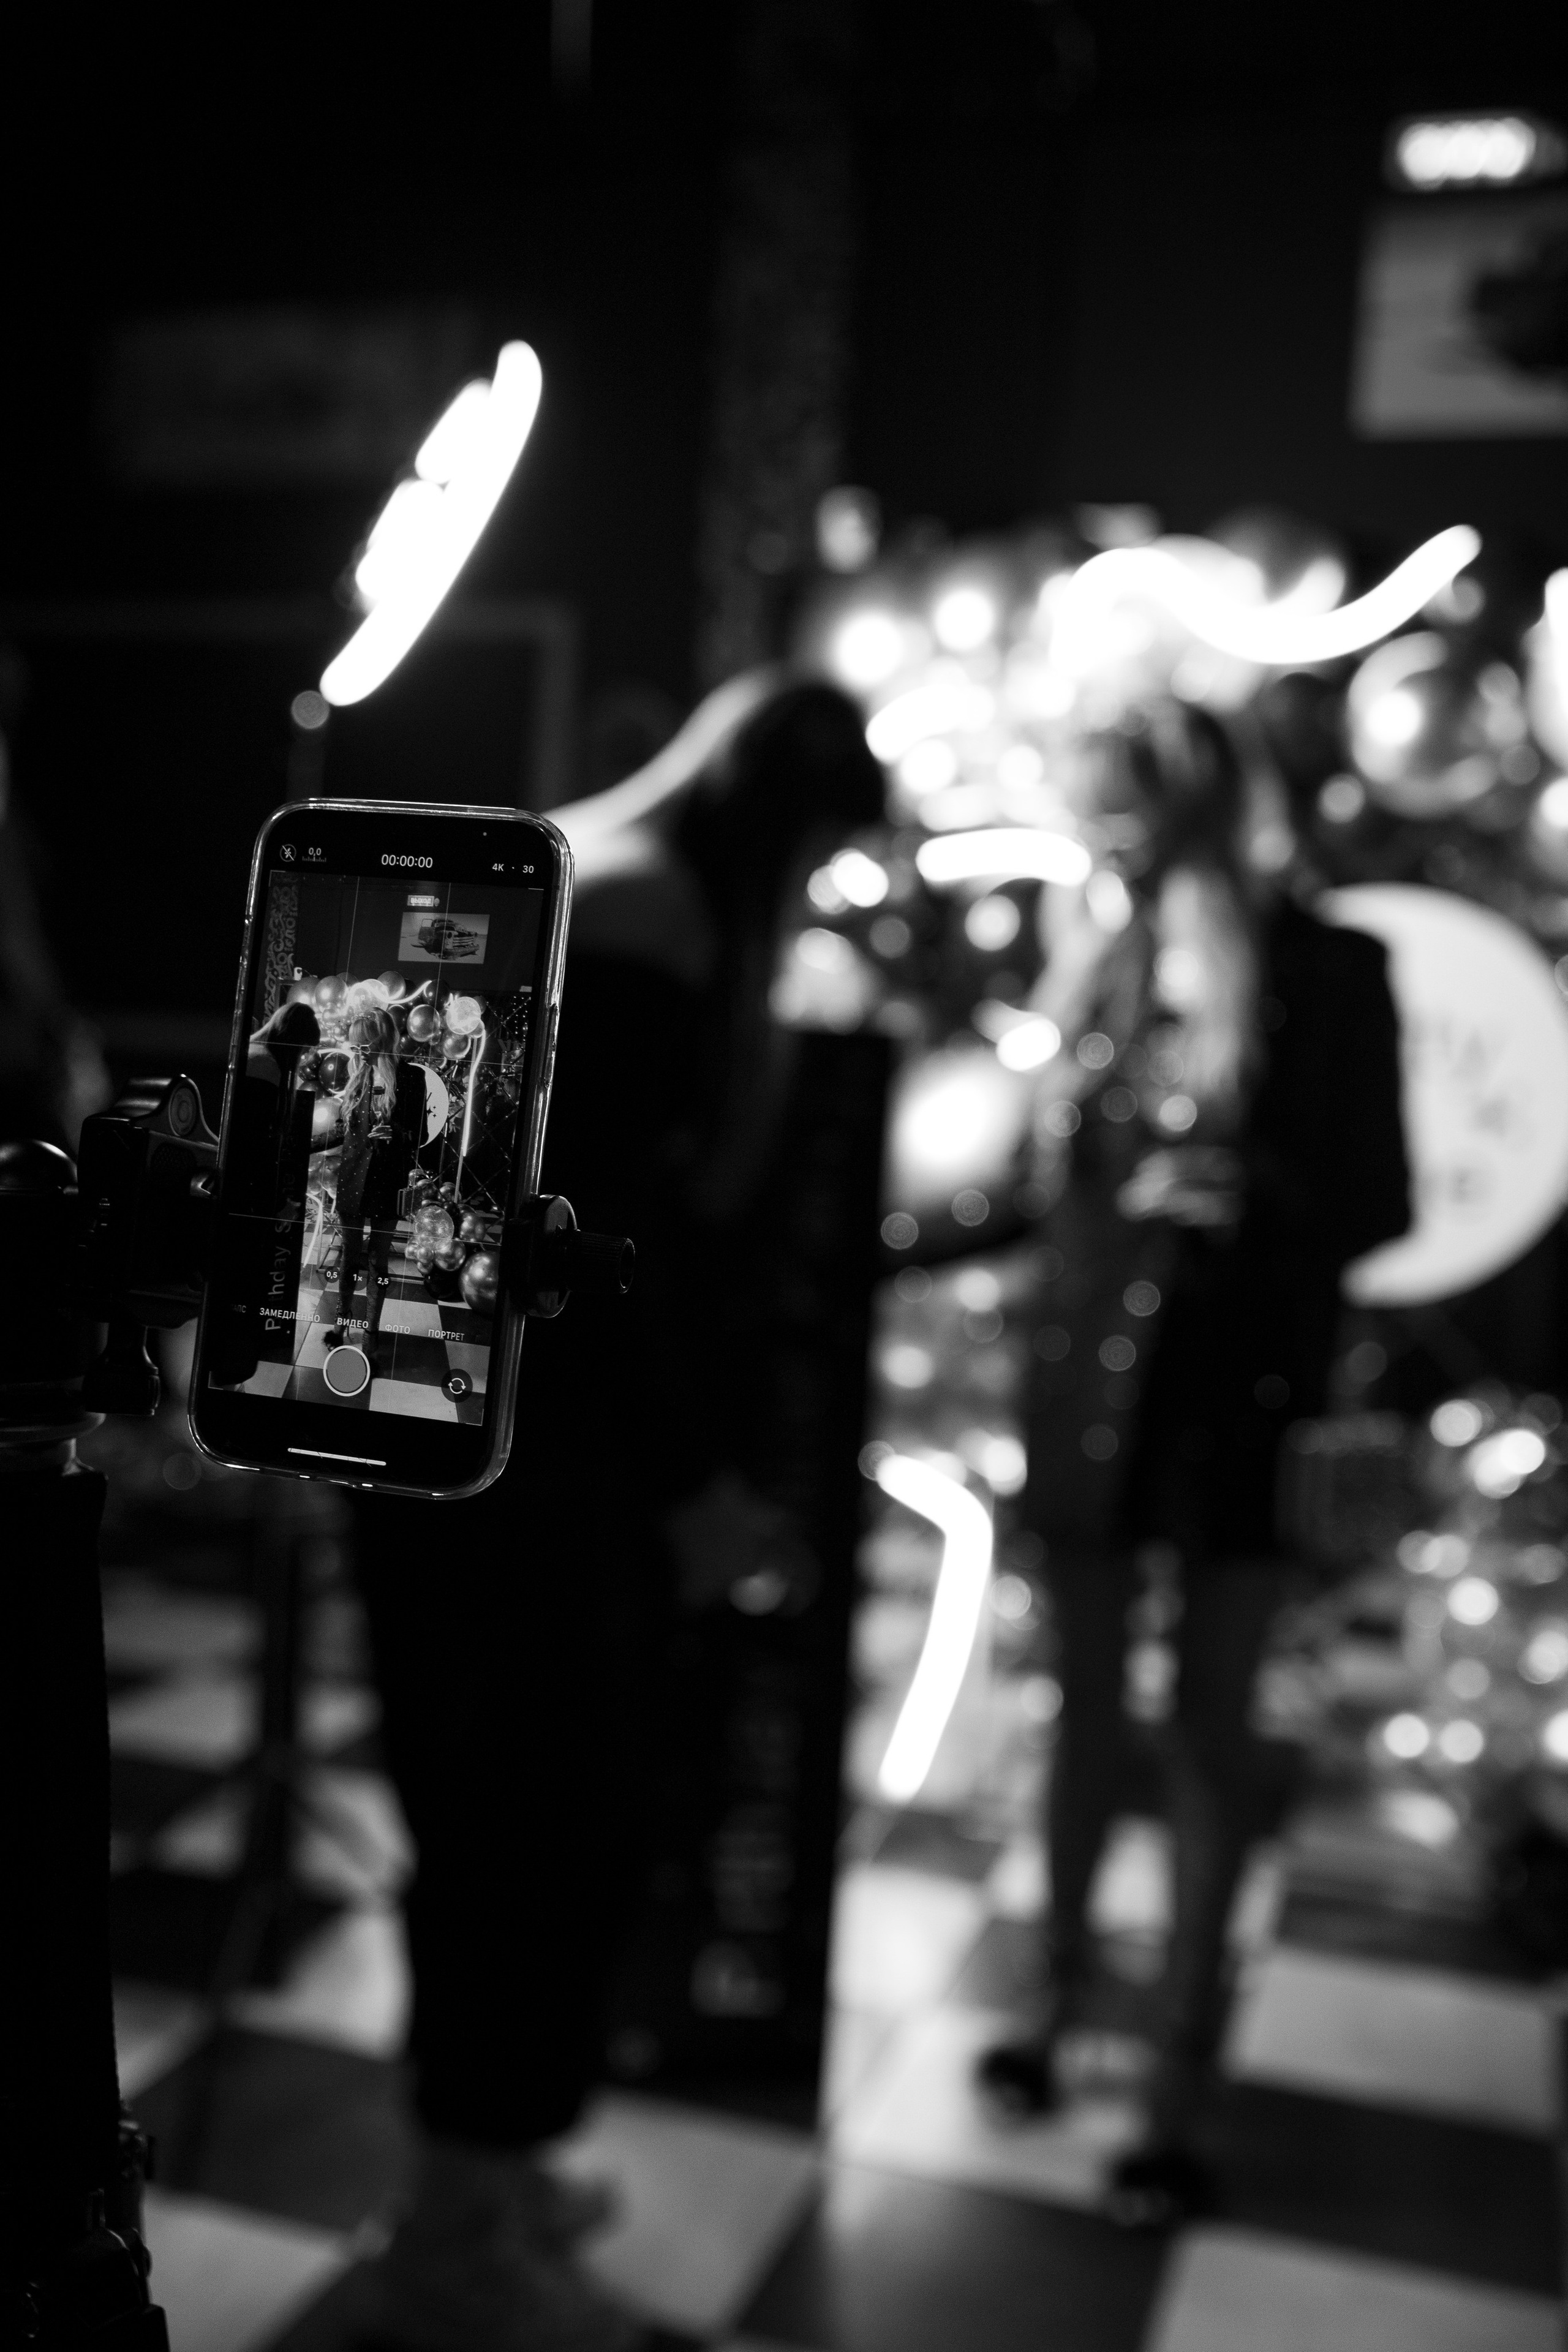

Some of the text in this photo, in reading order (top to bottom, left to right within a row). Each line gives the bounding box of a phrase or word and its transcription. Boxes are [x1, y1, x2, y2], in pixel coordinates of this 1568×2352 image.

[381, 854, 433, 869] 00:00:00
[492, 863, 534, 874] 4K 30
[326, 1271, 337, 1280] 0,5
[377, 1277, 389, 1286] 2,5
[259, 1307, 320, 1322] ЗАМЕДЛЕННО
[336, 1317, 369, 1329] ВИДЕО
[385, 1324, 410, 1335] ФОТО
[428, 1329, 465, 1341] ПОРТРЕТ
